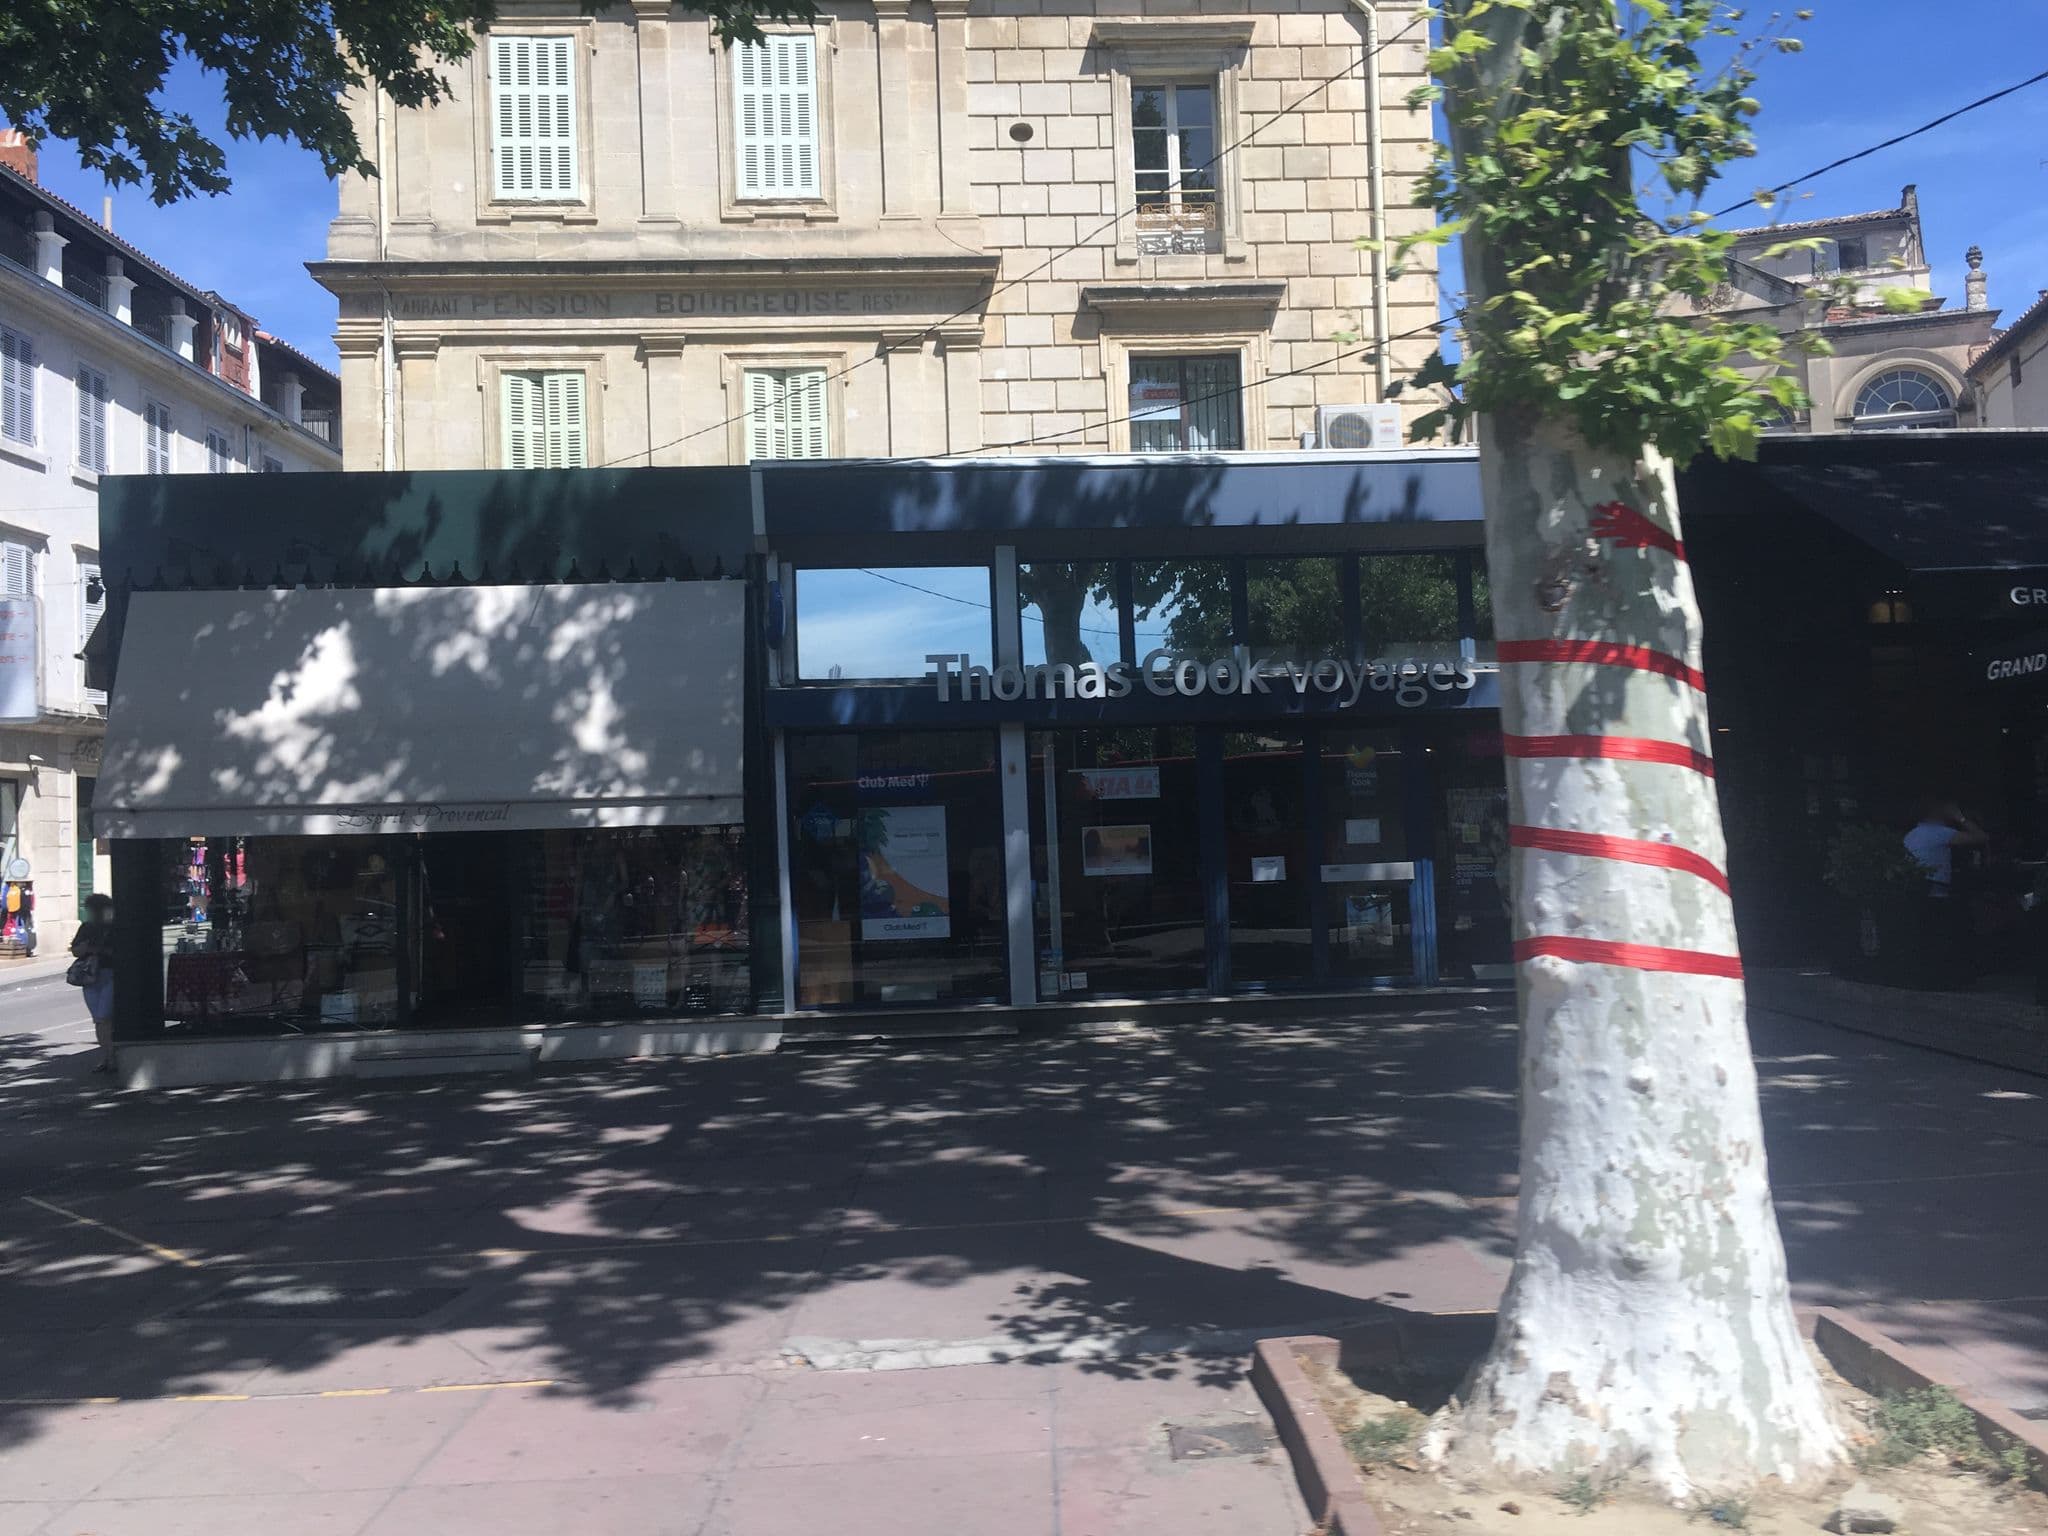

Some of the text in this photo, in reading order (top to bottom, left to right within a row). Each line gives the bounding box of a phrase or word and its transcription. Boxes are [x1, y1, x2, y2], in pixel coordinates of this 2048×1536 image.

[472, 294, 612, 316] PENSION
[656, 290, 852, 314] BOURGEOISE
[926, 644, 1478, 708] Thomas Cook voyages
[1987, 653, 2047, 681] GRAND
[857, 774, 916, 788] Club Med
[335, 808, 406, 828] Esprit
